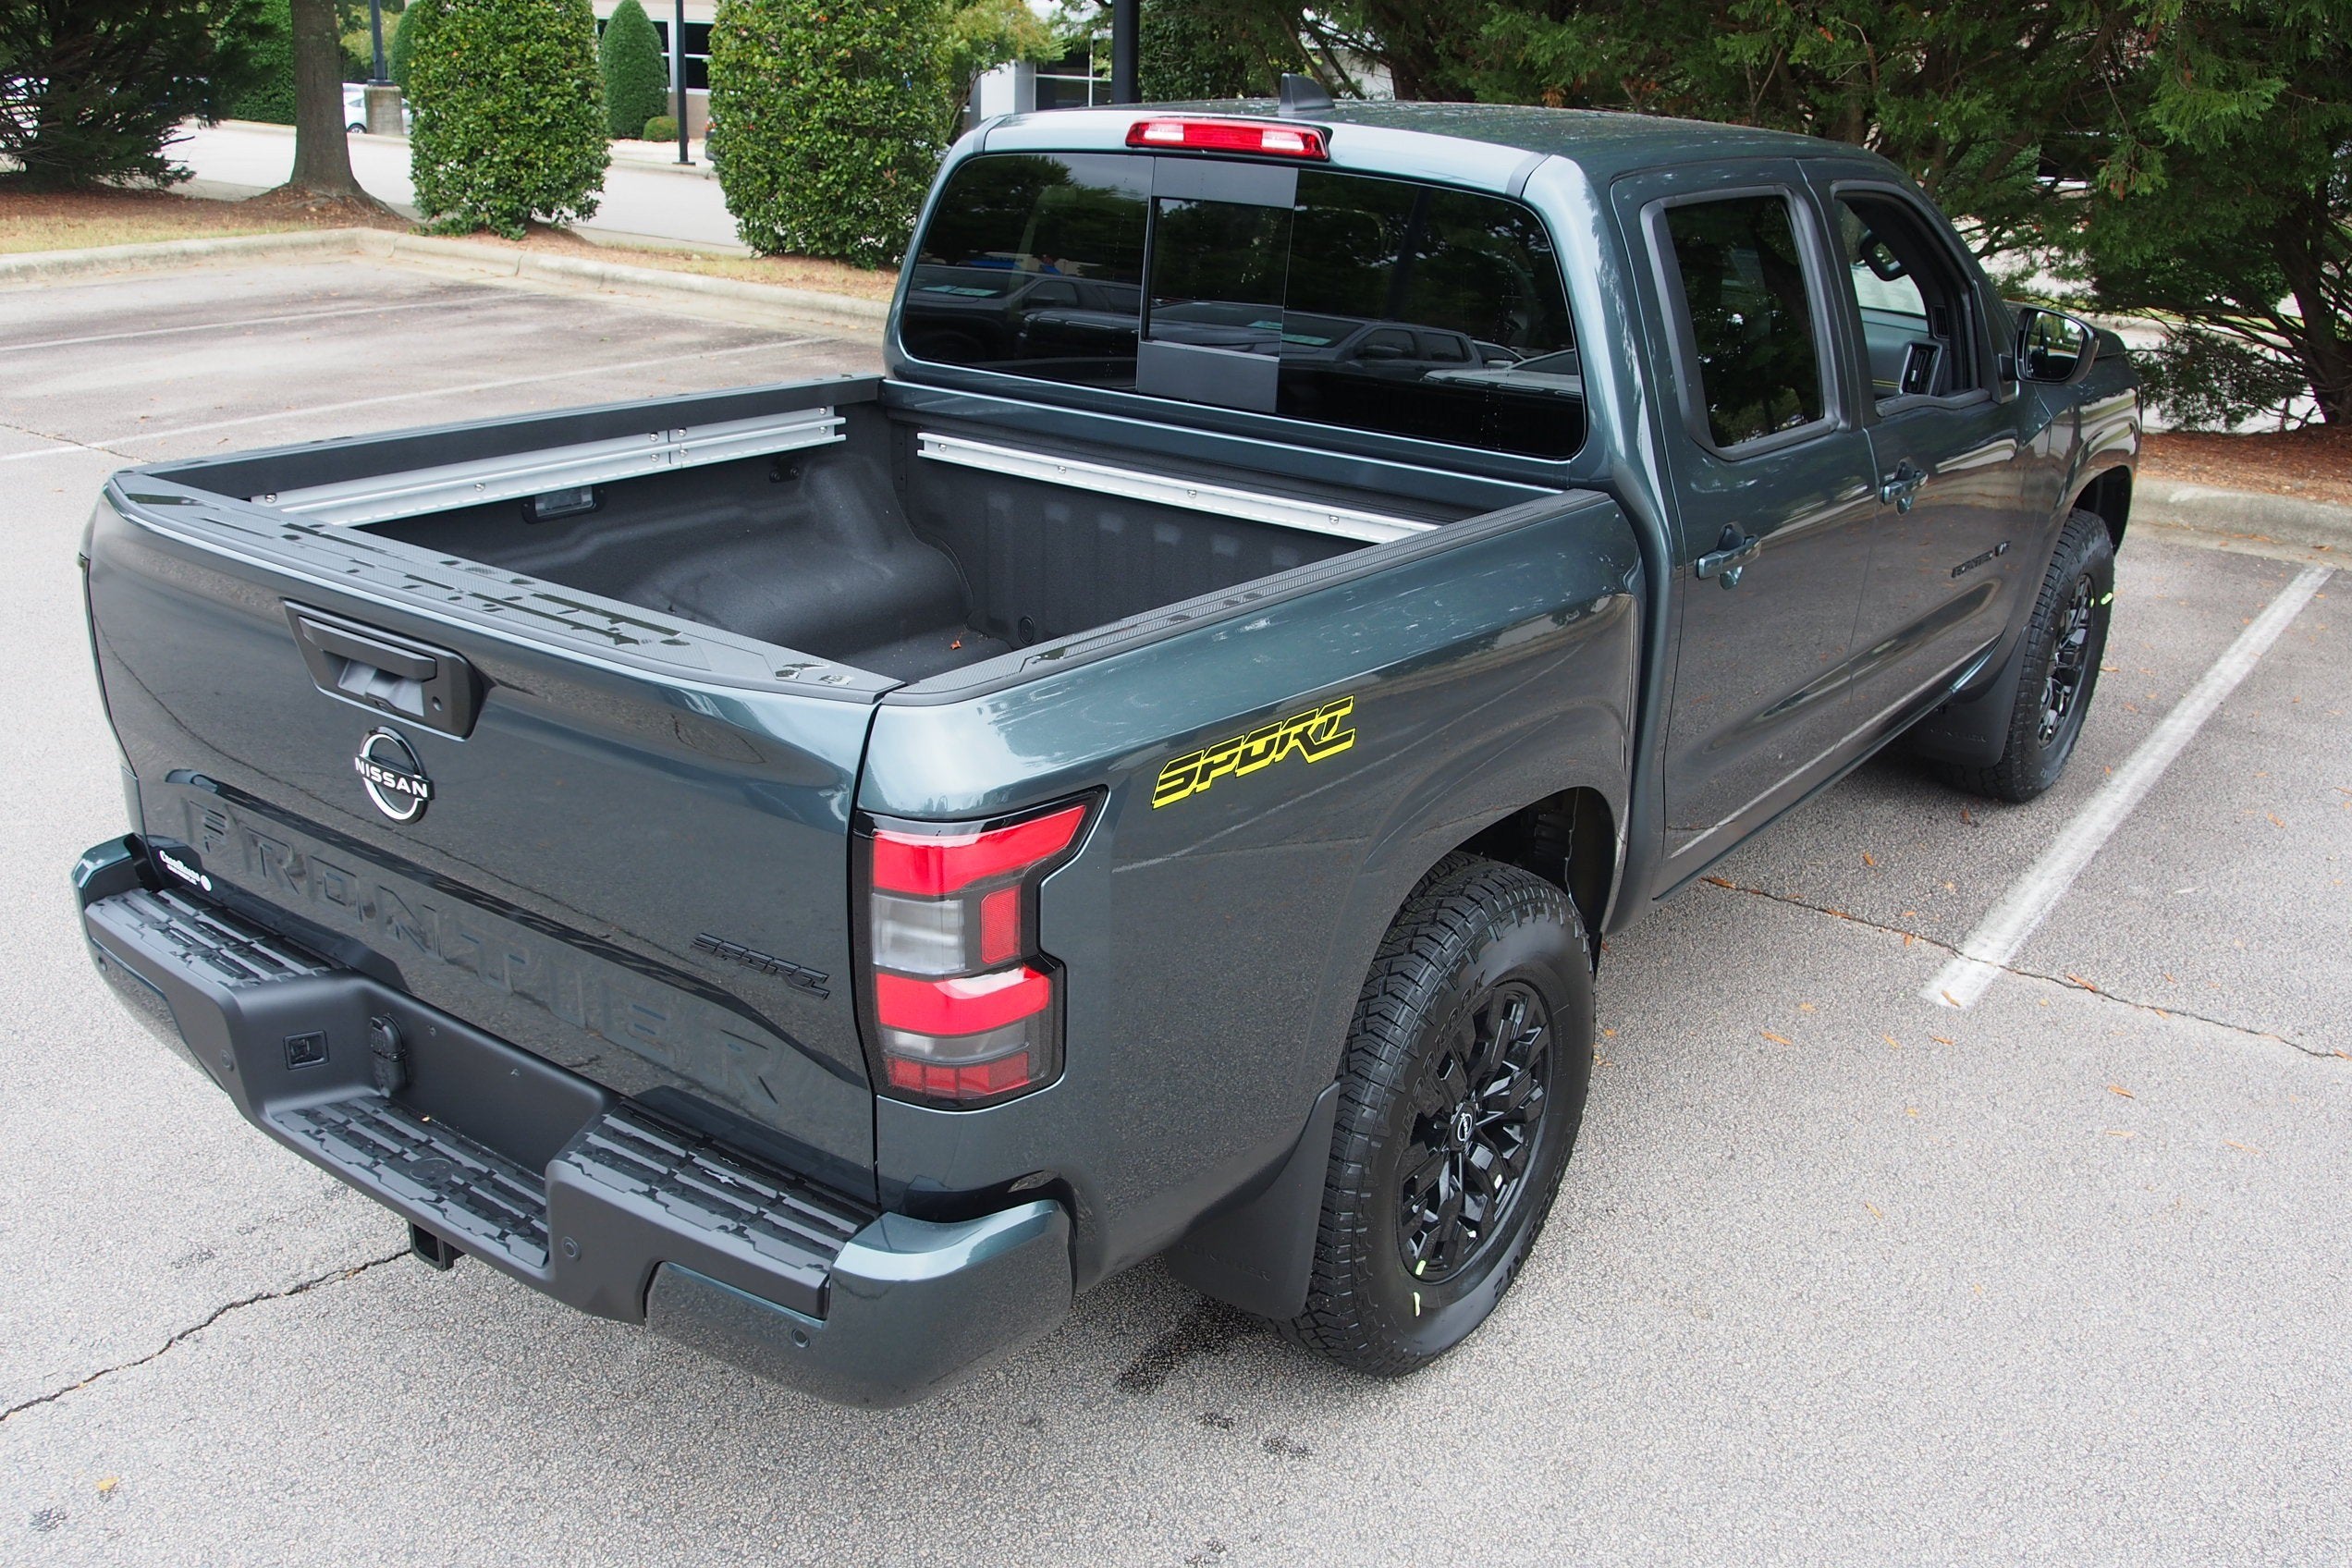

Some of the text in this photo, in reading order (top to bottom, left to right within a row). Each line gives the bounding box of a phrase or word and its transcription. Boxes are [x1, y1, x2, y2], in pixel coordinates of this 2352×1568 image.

[354, 756, 429, 798] NISSAN
[1152, 695, 1356, 810] SPORT
[180, 797, 783, 1109] FRONTIER
[691, 932, 830, 1000] SPORT
